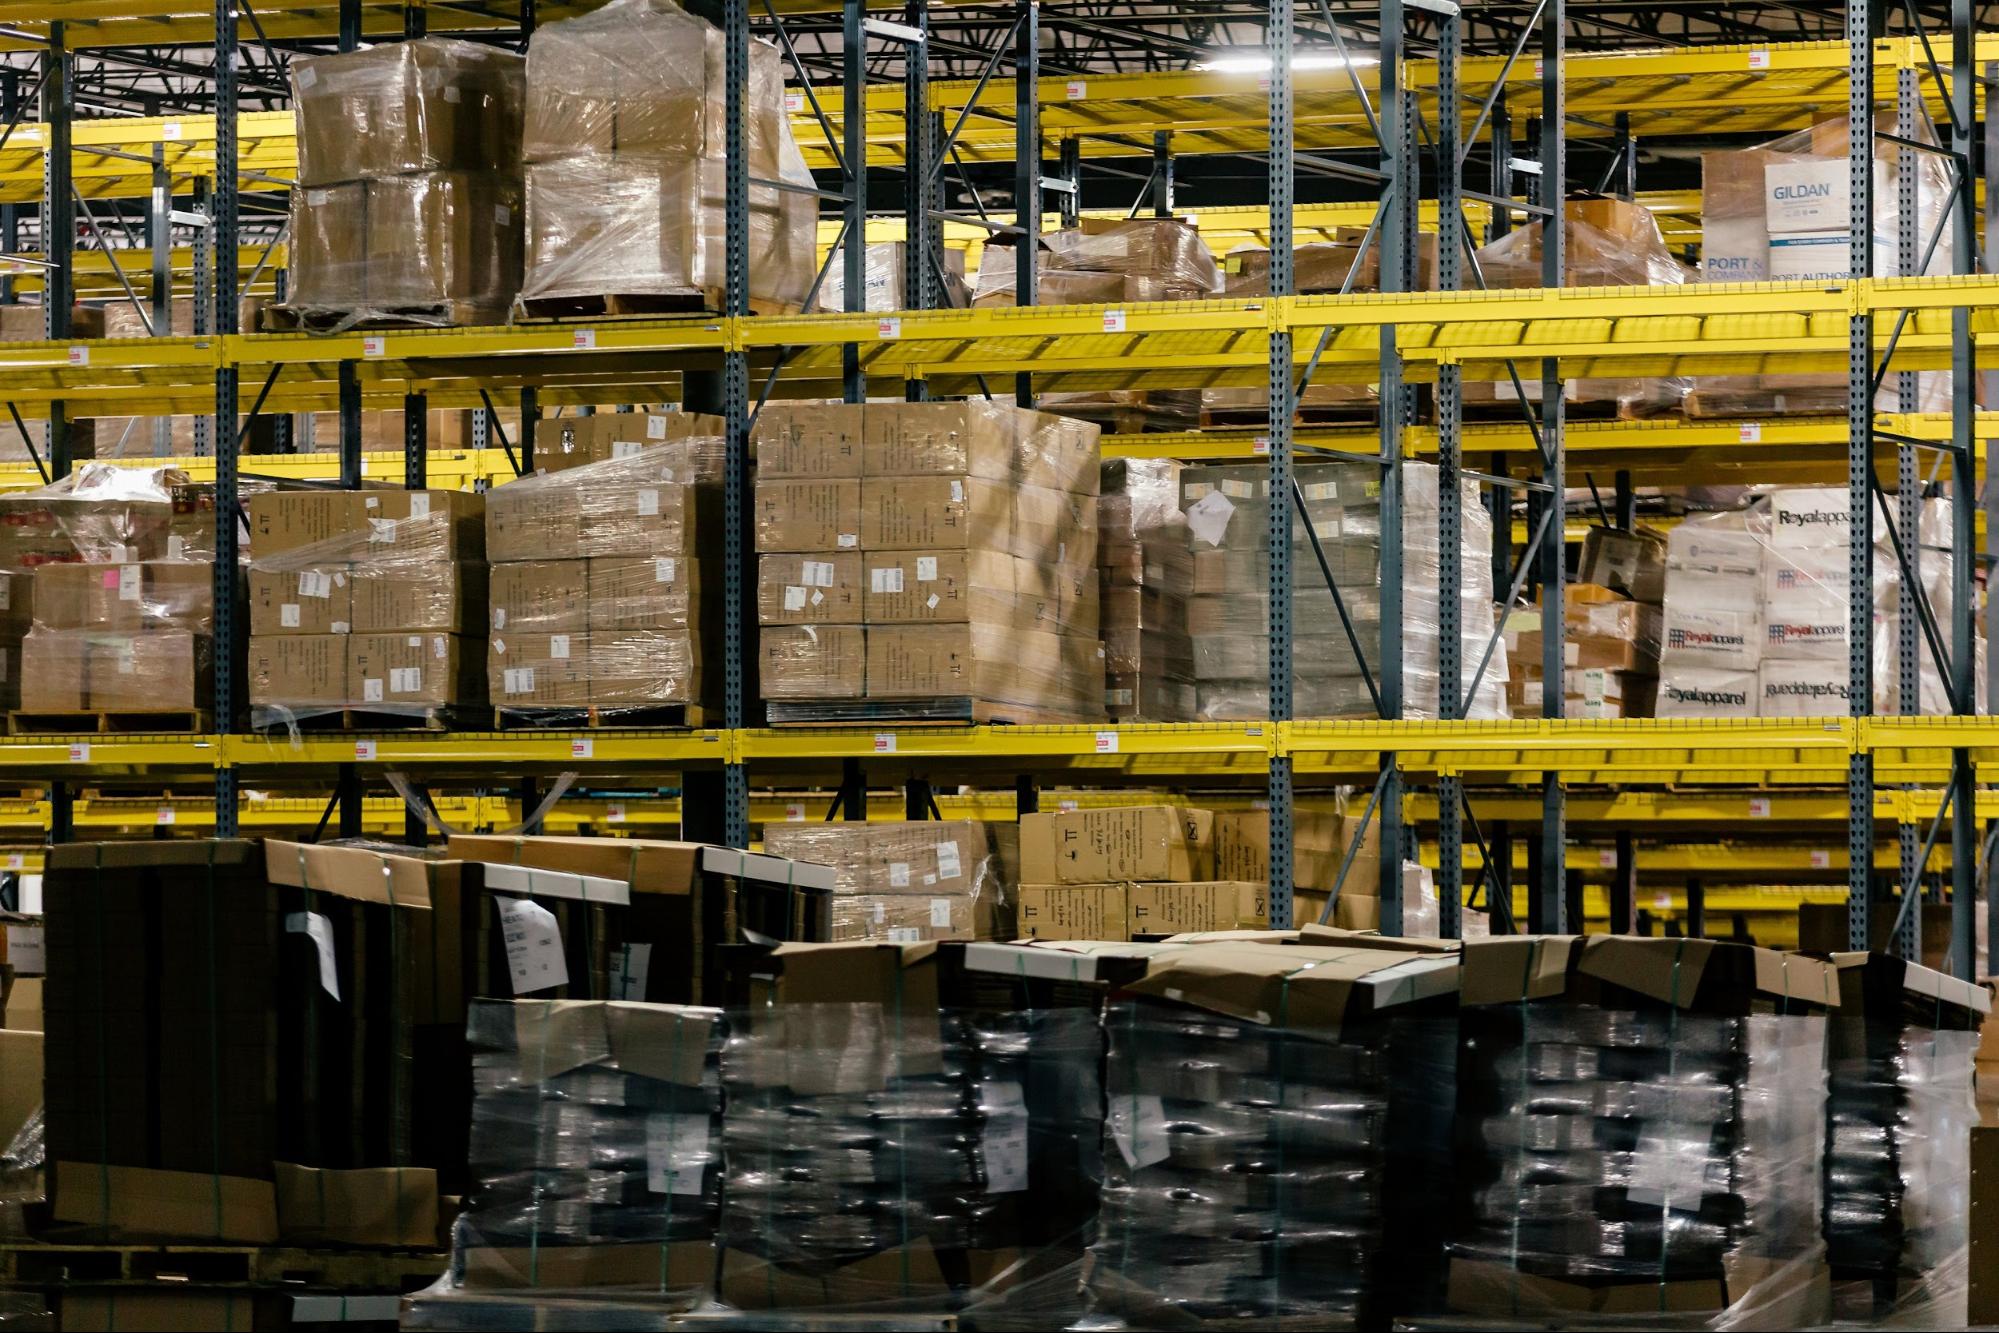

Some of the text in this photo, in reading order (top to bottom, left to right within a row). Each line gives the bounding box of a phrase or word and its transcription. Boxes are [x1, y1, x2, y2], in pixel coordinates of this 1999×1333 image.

[1773, 183, 1829, 200] GILDAN
[1708, 257, 1763, 270] PORT &
[1771, 271, 1850, 281] PORT AUTHOR
